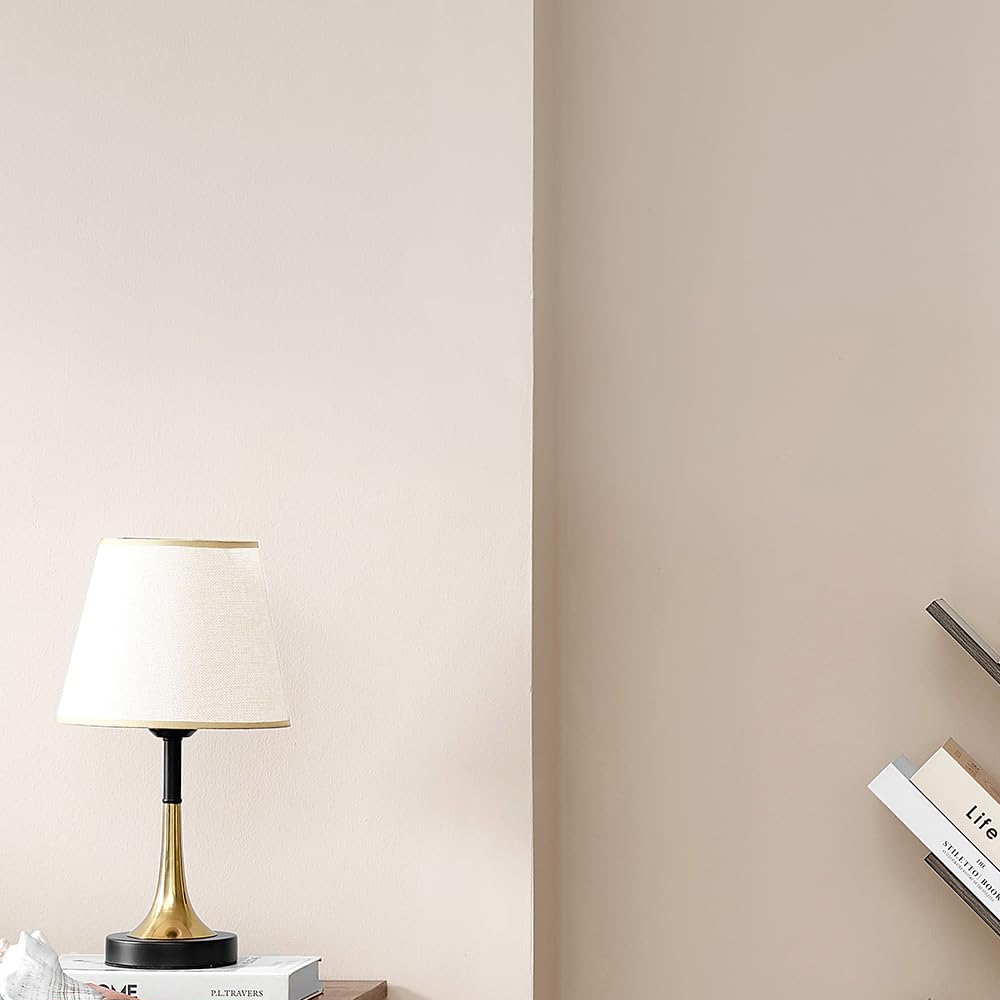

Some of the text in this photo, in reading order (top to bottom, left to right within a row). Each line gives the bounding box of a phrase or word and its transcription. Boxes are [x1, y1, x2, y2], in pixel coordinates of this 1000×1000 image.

[965, 805, 998, 840] Life
[942, 840, 979, 877] STILETTO
[976, 859, 986, 869] THE
[210, 989, 264, 997] P.L.TRAVERS
